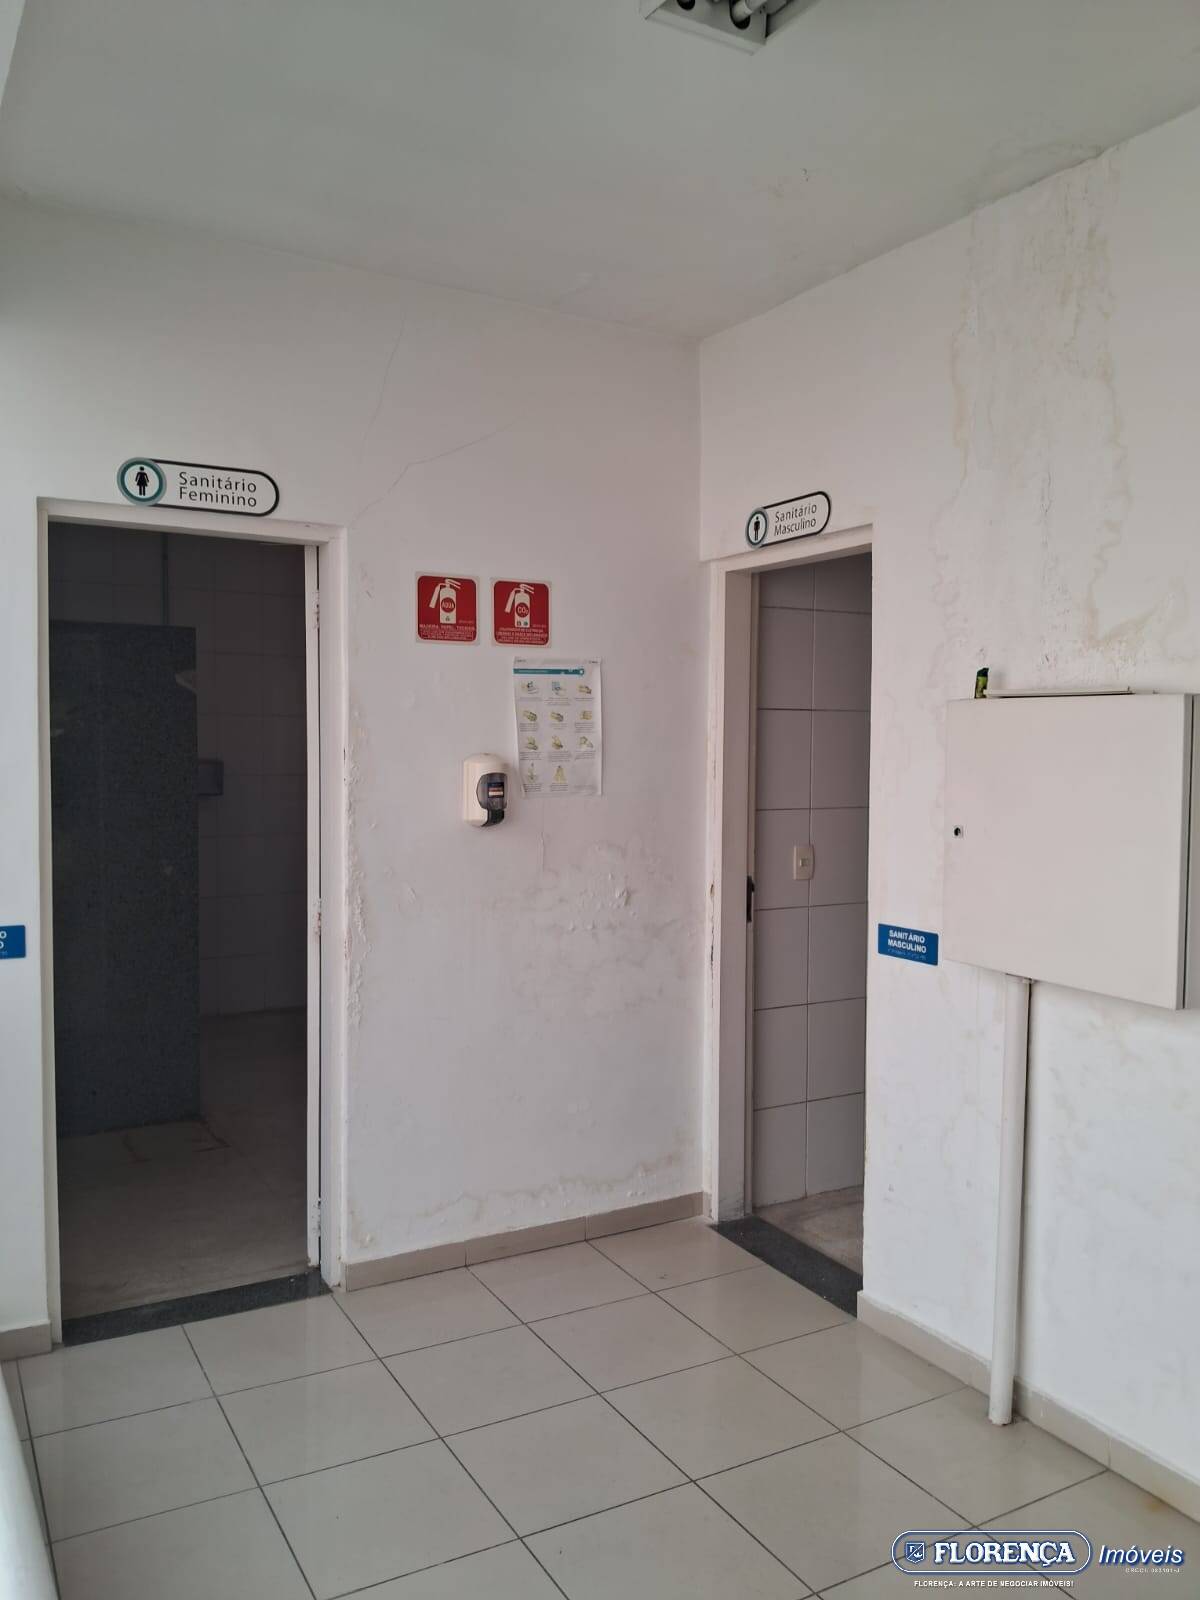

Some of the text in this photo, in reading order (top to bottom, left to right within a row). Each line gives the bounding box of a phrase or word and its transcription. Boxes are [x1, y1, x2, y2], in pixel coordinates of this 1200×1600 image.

[179, 472, 257, 493] Sanitário
[179, 487, 257, 508] Feminino
[775, 504, 817, 523] Sanitário
[774, 518, 817, 537] Masculino
[887, 938, 927, 953] MASCULINO
[888, 929, 926, 944] SANITÁRIO
